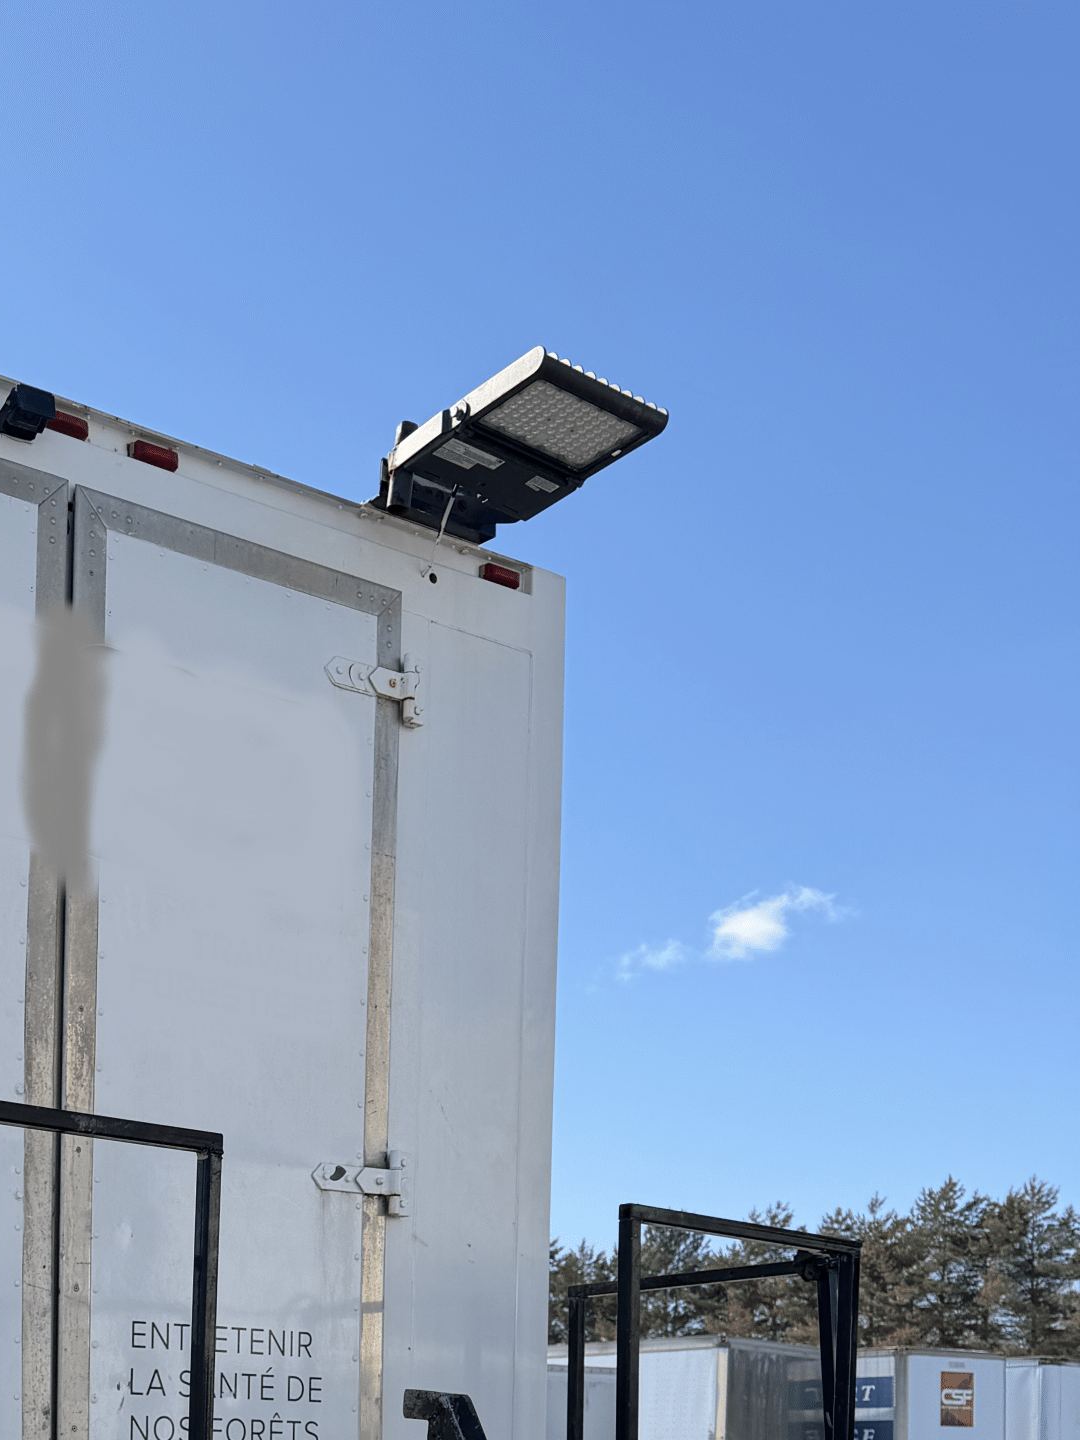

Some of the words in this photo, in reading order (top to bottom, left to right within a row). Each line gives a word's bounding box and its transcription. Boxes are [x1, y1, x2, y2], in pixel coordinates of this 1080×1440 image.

[131, 1320, 313, 1358] ENTETENIR
[129, 1368, 166, 1396] LA
[178, 1366, 275, 1401] SNTÉ
[287, 1375, 323, 1403] DE
